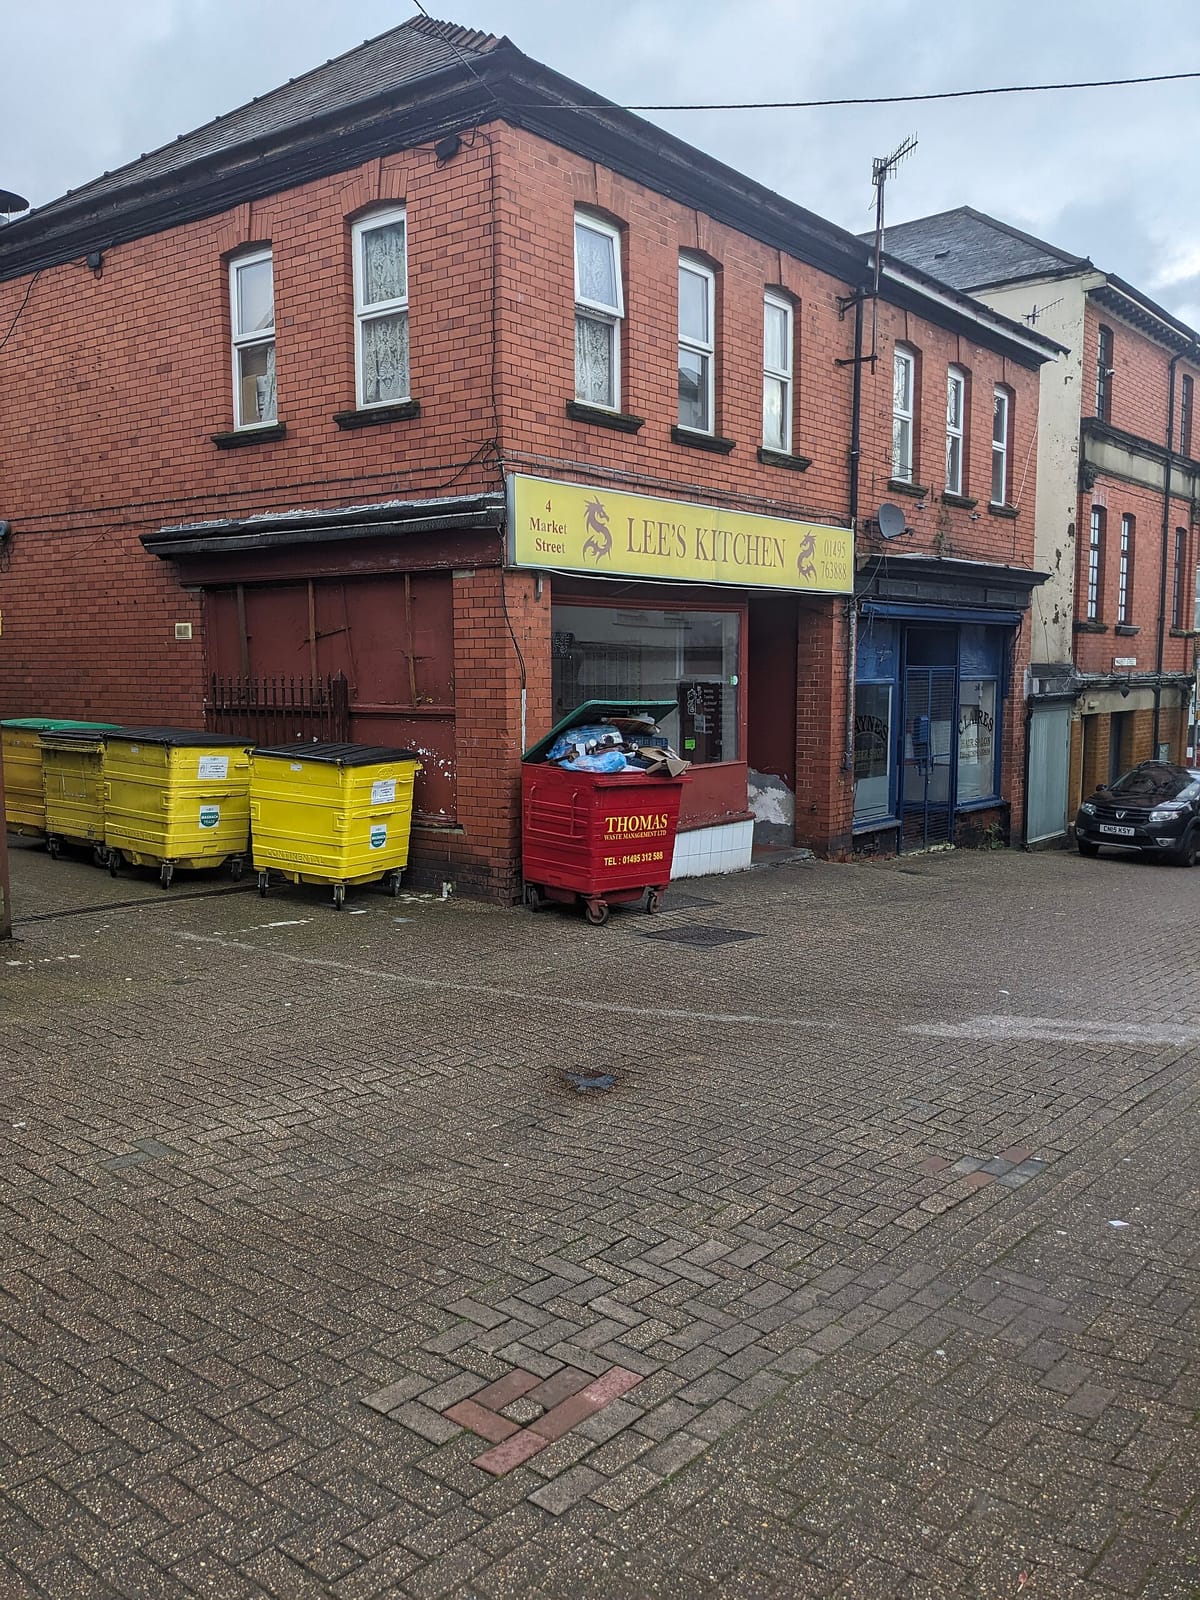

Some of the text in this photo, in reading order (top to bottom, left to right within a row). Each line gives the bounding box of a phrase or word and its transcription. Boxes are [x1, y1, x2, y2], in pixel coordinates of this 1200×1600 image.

[545, 500, 552, 513] 4
[529, 516, 568, 534] Market
[535, 537, 566, 554] Street
[627, 517, 787, 568] LEE'S KITCHEN
[823, 539, 846, 559] 01495
[605, 813, 668, 833] THOMAS
[623, 831, 657, 839] MANAGEMENT
[656, 829, 667, 837] LTD
[604, 857, 617, 867] TEL
[622, 854, 641, 864] 01495
[641, 853, 652, 862] 312
